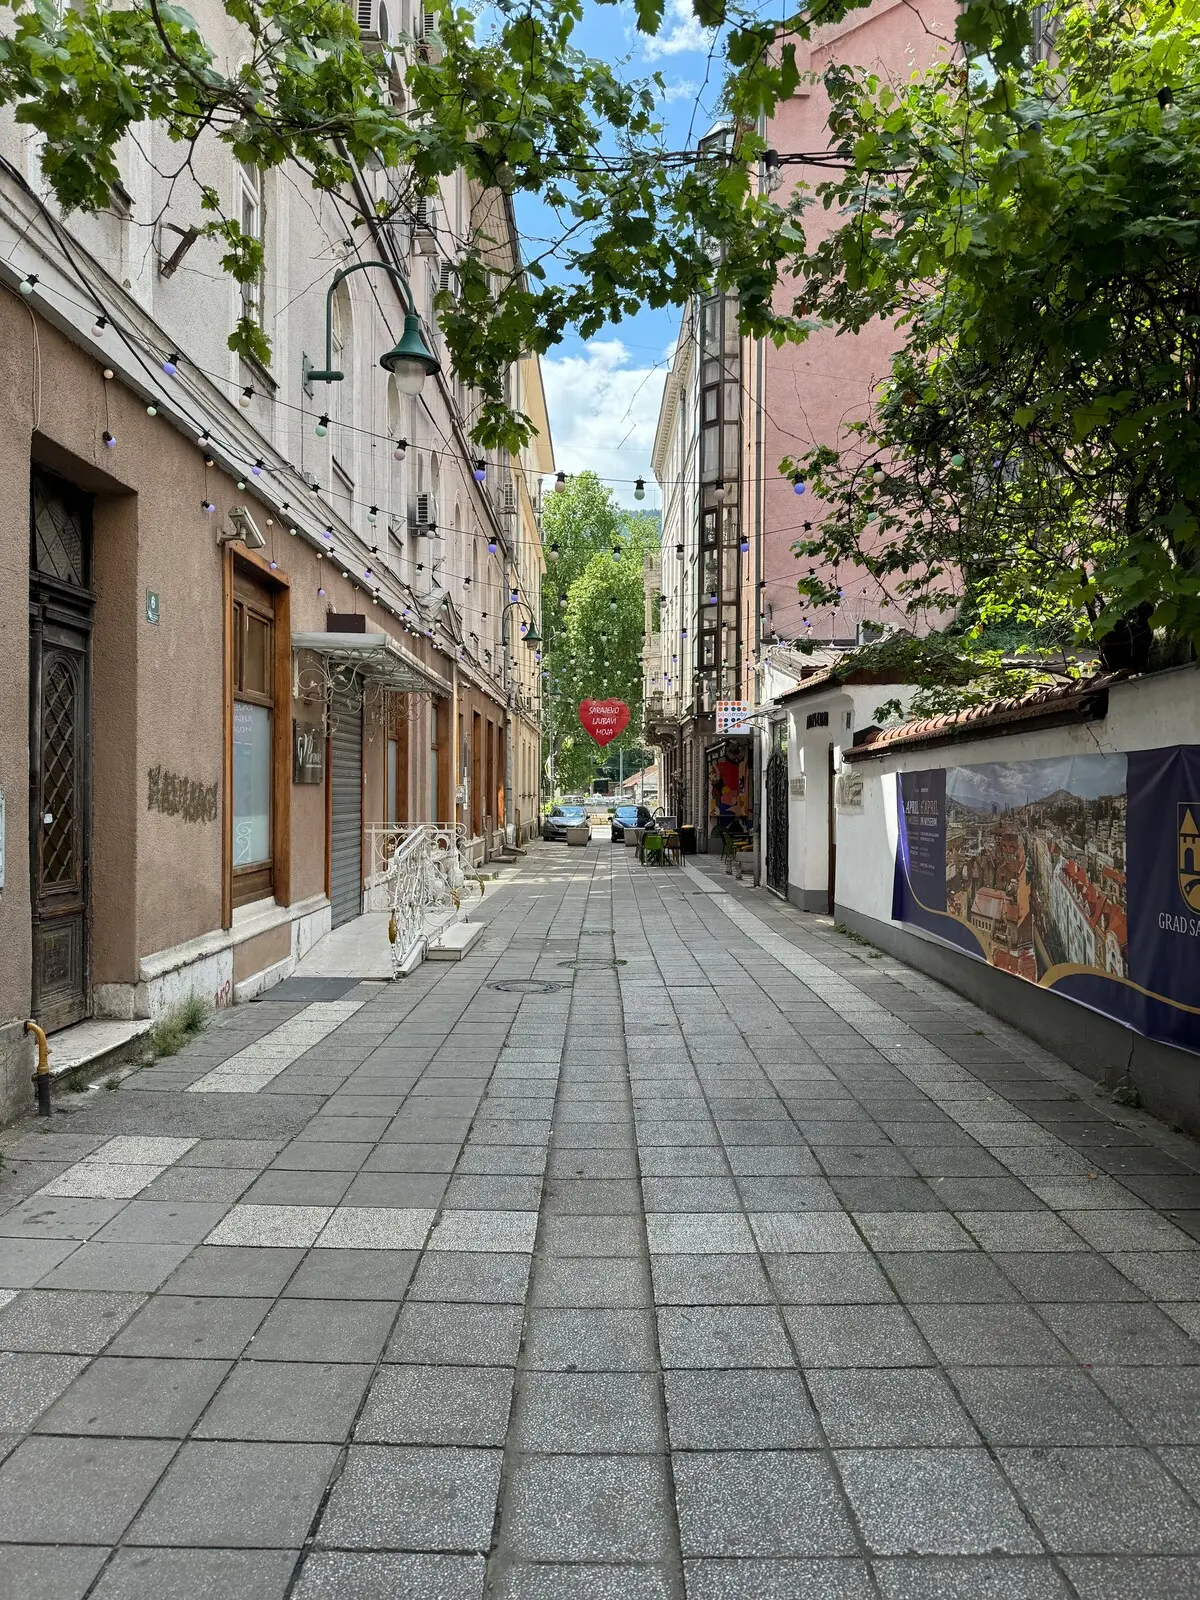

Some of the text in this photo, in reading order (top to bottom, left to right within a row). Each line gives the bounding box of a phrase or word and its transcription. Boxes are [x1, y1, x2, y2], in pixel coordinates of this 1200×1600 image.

[588, 706, 620, 714] SARAJEVO
[592, 717, 617, 725] LJUBAVI
[595, 728, 614, 736] MOJA
[1158, 912, 1187, 934] GRAD
